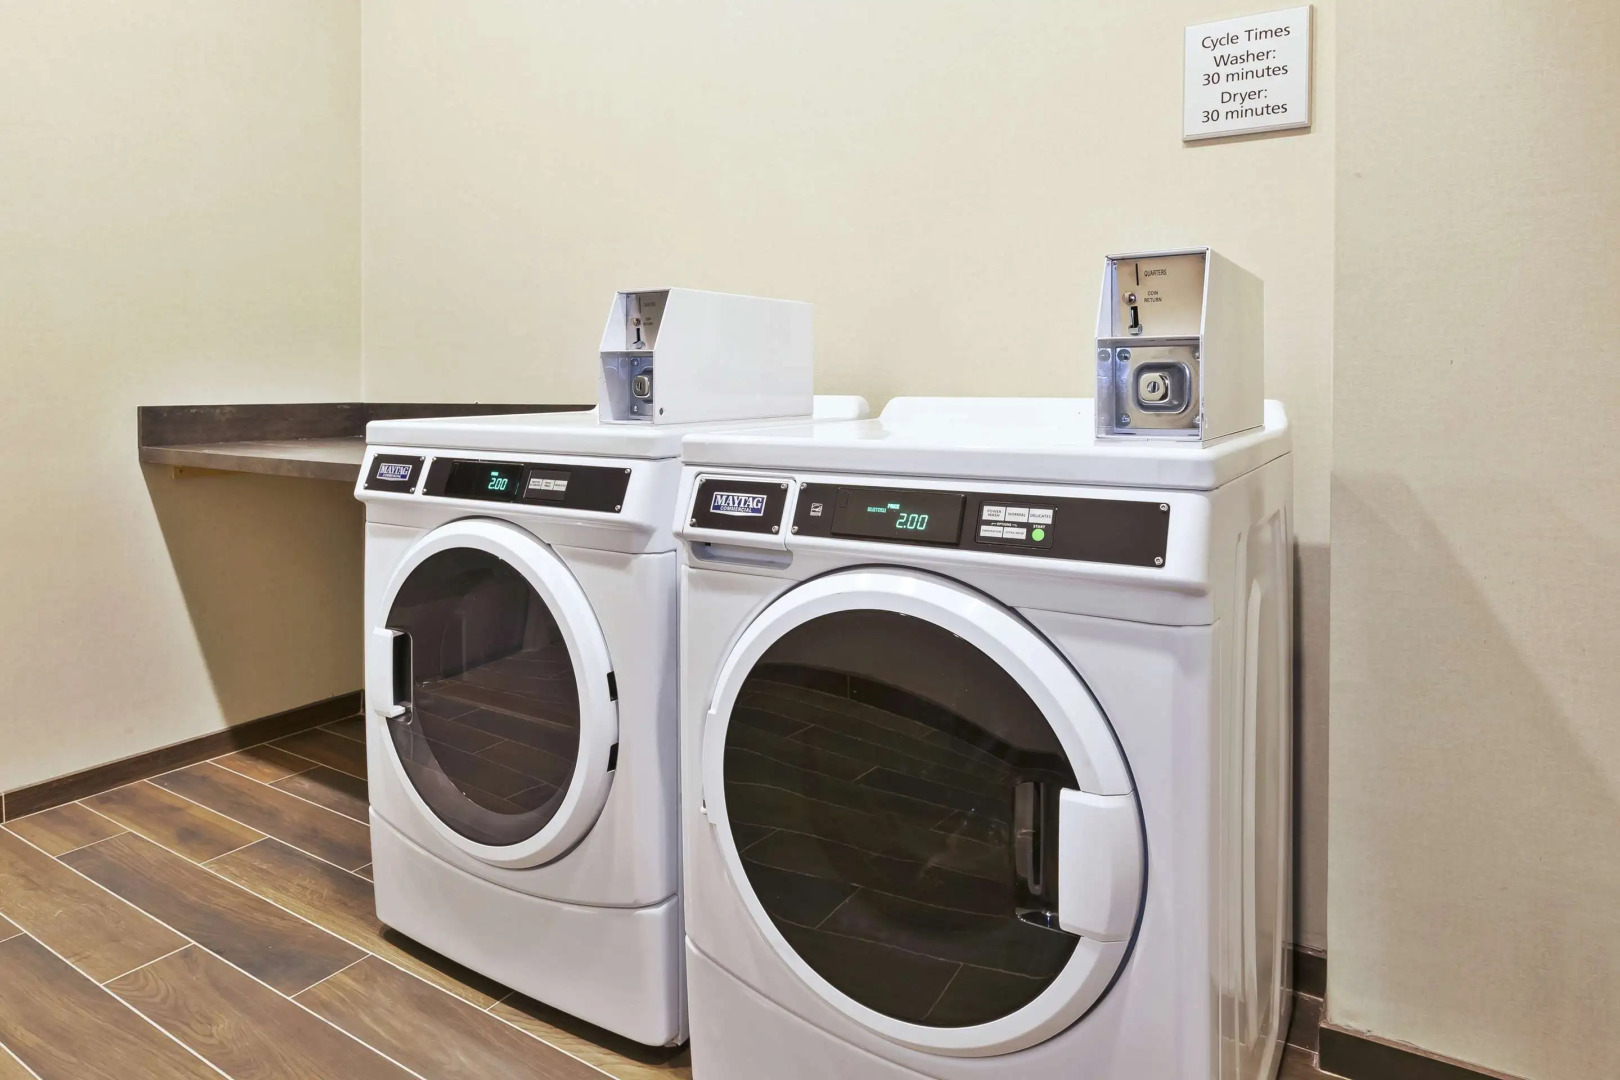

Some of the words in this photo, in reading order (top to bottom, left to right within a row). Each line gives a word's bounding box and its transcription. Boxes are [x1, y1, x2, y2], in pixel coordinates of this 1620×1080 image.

[1201, 32, 1239, 51] Cycle
[1244, 26, 1291, 42] Times
[1213, 49, 1276, 67] Washer:
[1202, 72, 1220, 86] 30
[1226, 64, 1288, 82] minutes
[1221, 88, 1267, 105] Dryer:
[1201, 109, 1219, 123] 30
[1225, 103, 1288, 120] minutes
[1143, 269, 1167, 277] QUARTERS
[379, 465, 408, 475] MAYTAG
[488, 477, 508, 491] 2.00
[714, 494, 762, 509] MAYTAG
[896, 513, 928, 530] 2.00
